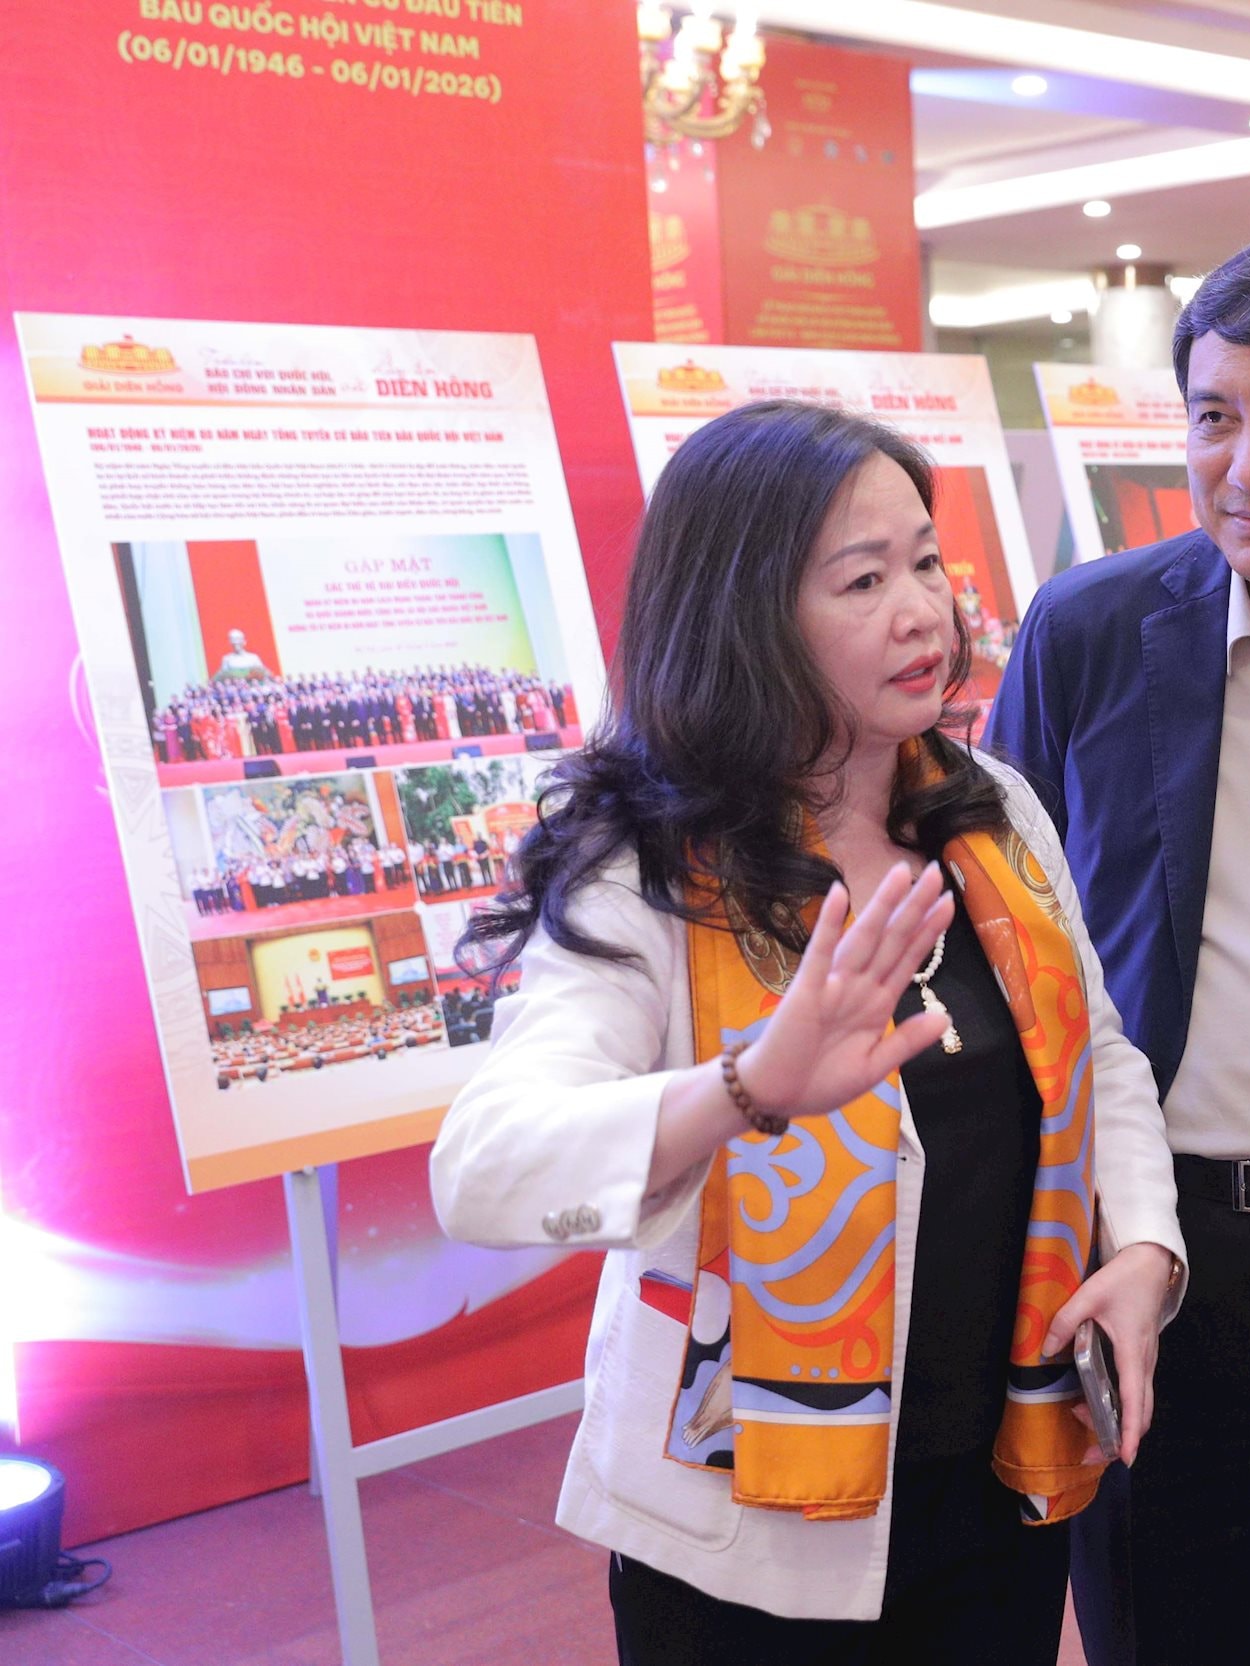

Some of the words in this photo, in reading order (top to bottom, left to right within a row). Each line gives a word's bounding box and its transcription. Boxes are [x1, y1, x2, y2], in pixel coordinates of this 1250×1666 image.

[208, 1, 295, 37] QUỐC
[300, 12, 349, 49] HỘI
[353, 20, 415, 55] VIỆT
[420, 30, 480, 59] NAM
[117, 30, 305, 79] (06/01/1946
[330, 59, 502, 104] 06/01/2026)
